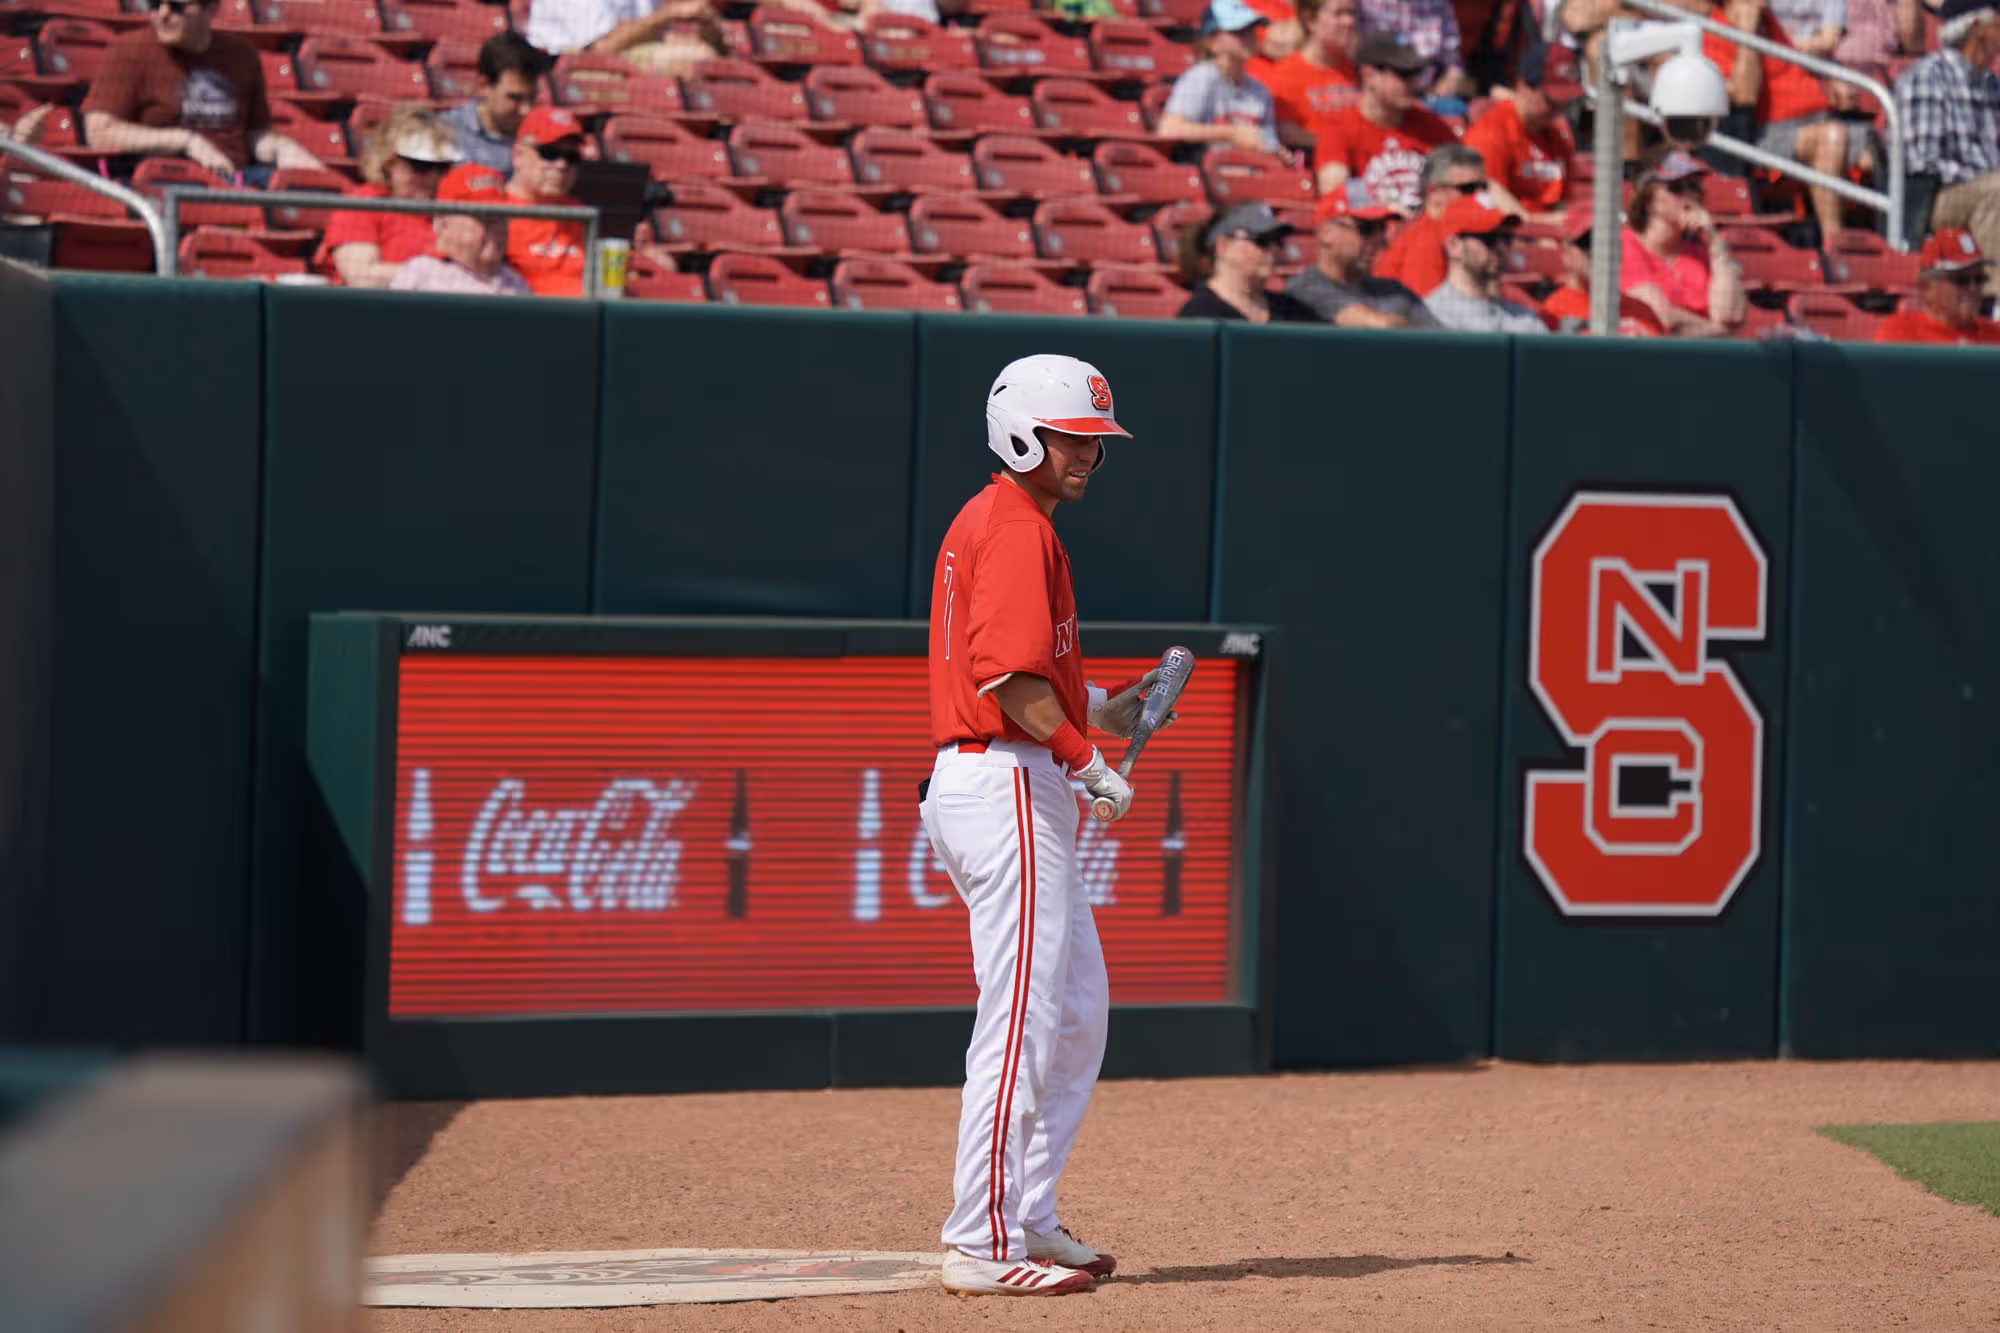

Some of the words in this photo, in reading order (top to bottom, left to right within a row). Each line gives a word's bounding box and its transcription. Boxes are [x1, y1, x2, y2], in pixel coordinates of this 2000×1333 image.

[407, 625, 450, 648] ANC
[1154, 649, 1185, 696] BURNER
[462, 778, 698, 912] Coca-Cola
